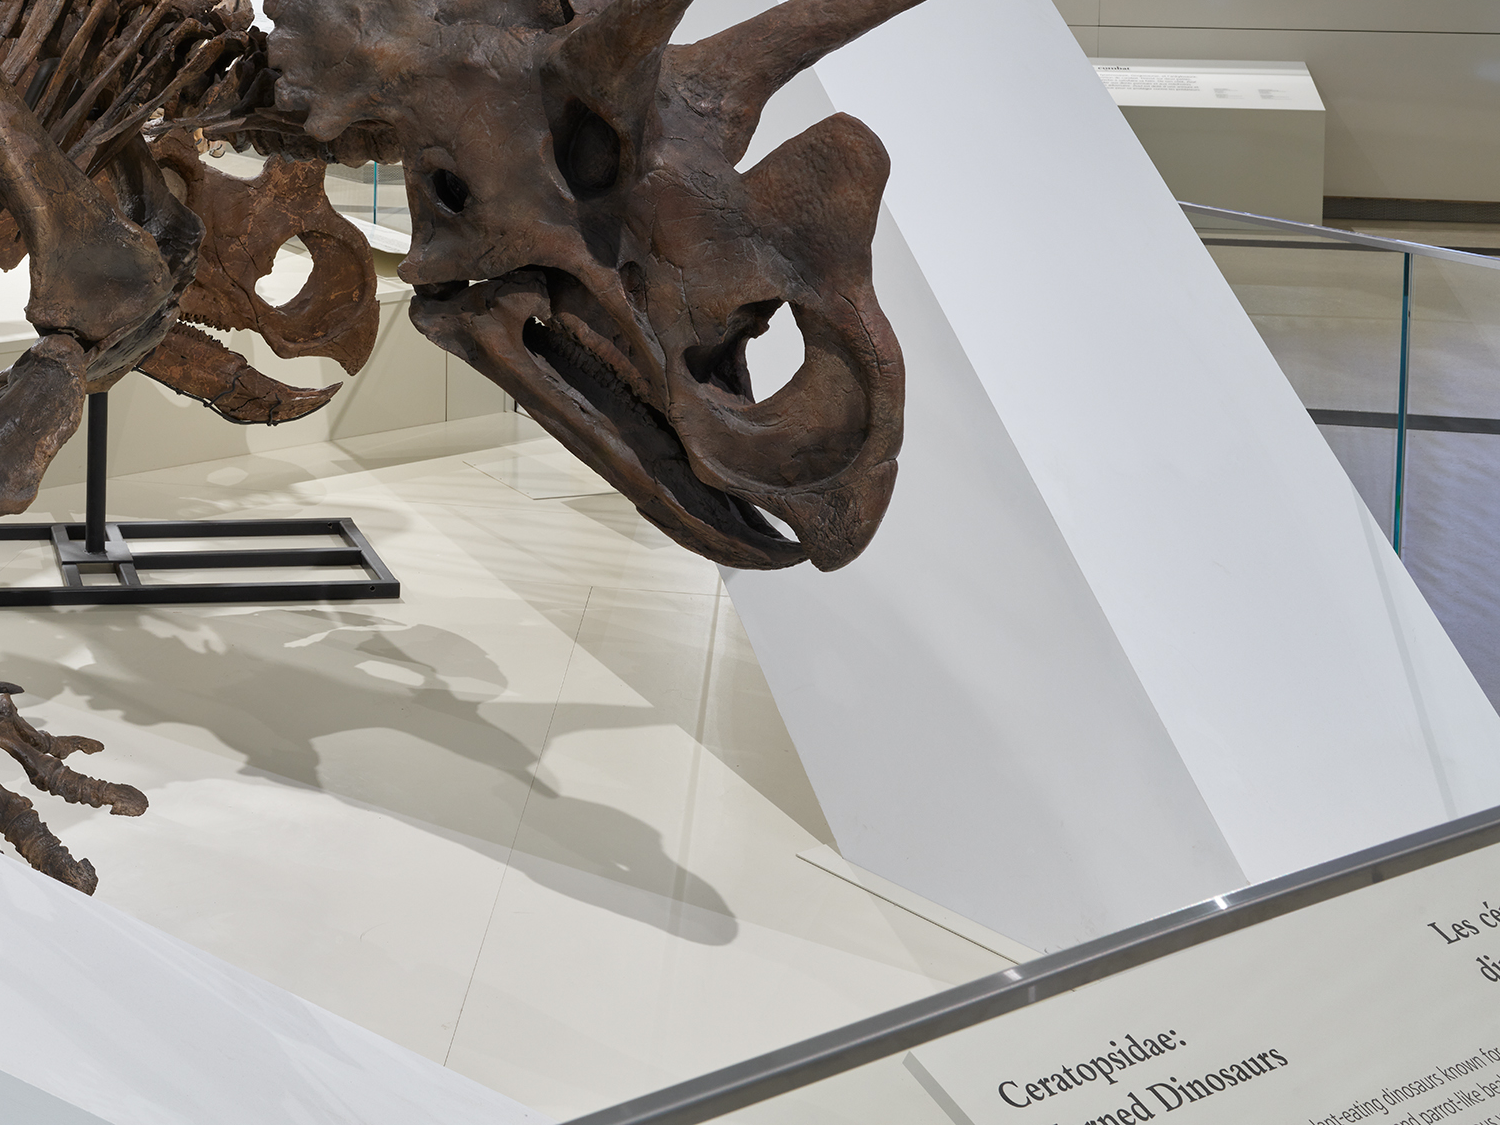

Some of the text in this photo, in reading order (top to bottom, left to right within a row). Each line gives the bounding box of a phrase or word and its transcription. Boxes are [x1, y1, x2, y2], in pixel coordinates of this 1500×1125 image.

[1427, 919, 1480, 945] Les
[998, 1029, 1187, 1109] Ceratopsidae:
[1145, 1048, 1289, 1113] Dinosaurs
[1381, 1073, 1445, 1106] dinosaurs
[1435, 1056, 1488, 1082] known
[1418, 1090, 1486, 1125] parrot-like
